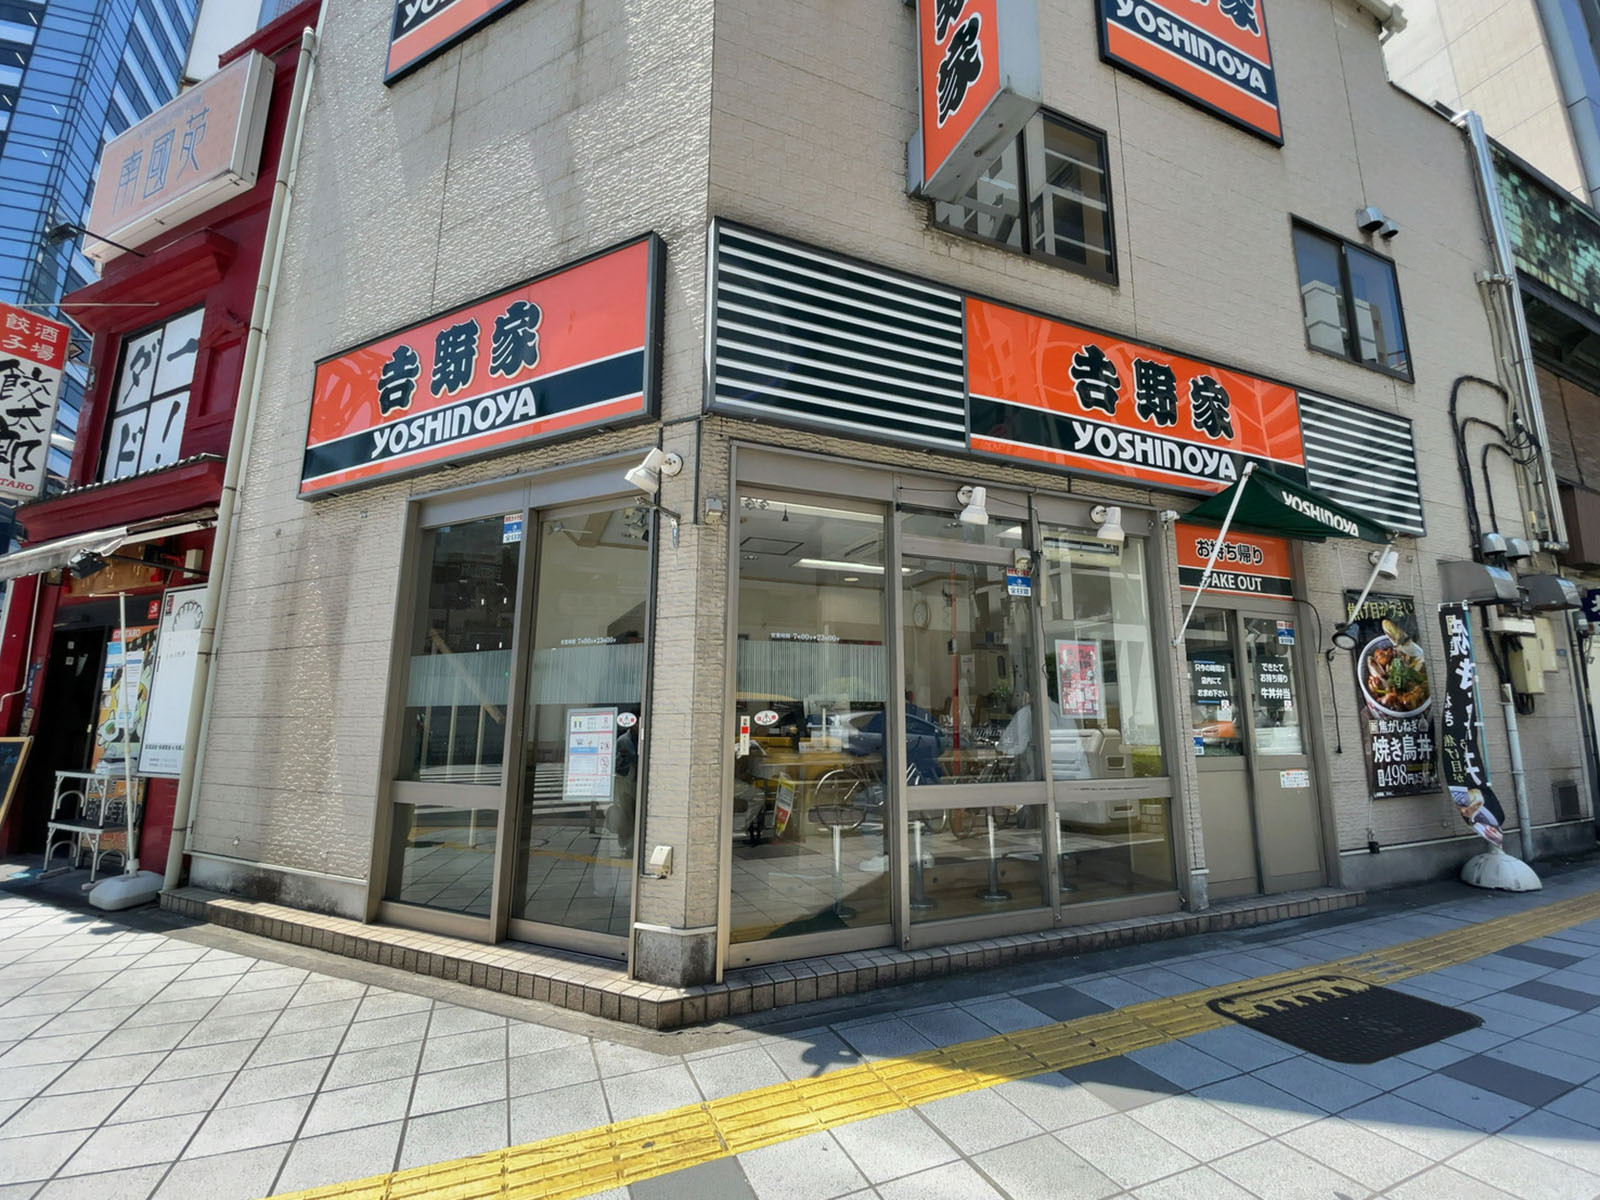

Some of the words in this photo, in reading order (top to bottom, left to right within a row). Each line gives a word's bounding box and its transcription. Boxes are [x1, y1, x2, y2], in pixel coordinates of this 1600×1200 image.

[1116, 0, 1267, 94] YOSHINOYA
[377, 300, 543, 416] 吉野家
[1069, 343, 1235, 440] 吉野家
[371, 386, 537, 459] YOSHINOYA
[1071, 420, 1238, 481] YOSHINOYA
[1282, 491, 1359, 537] YOSHINOYA
[1206, 571, 1236, 589] AKE
[1237, 575, 1262, 591] OUT
[1372, 734, 1433, 763] 焼き鳥丼
